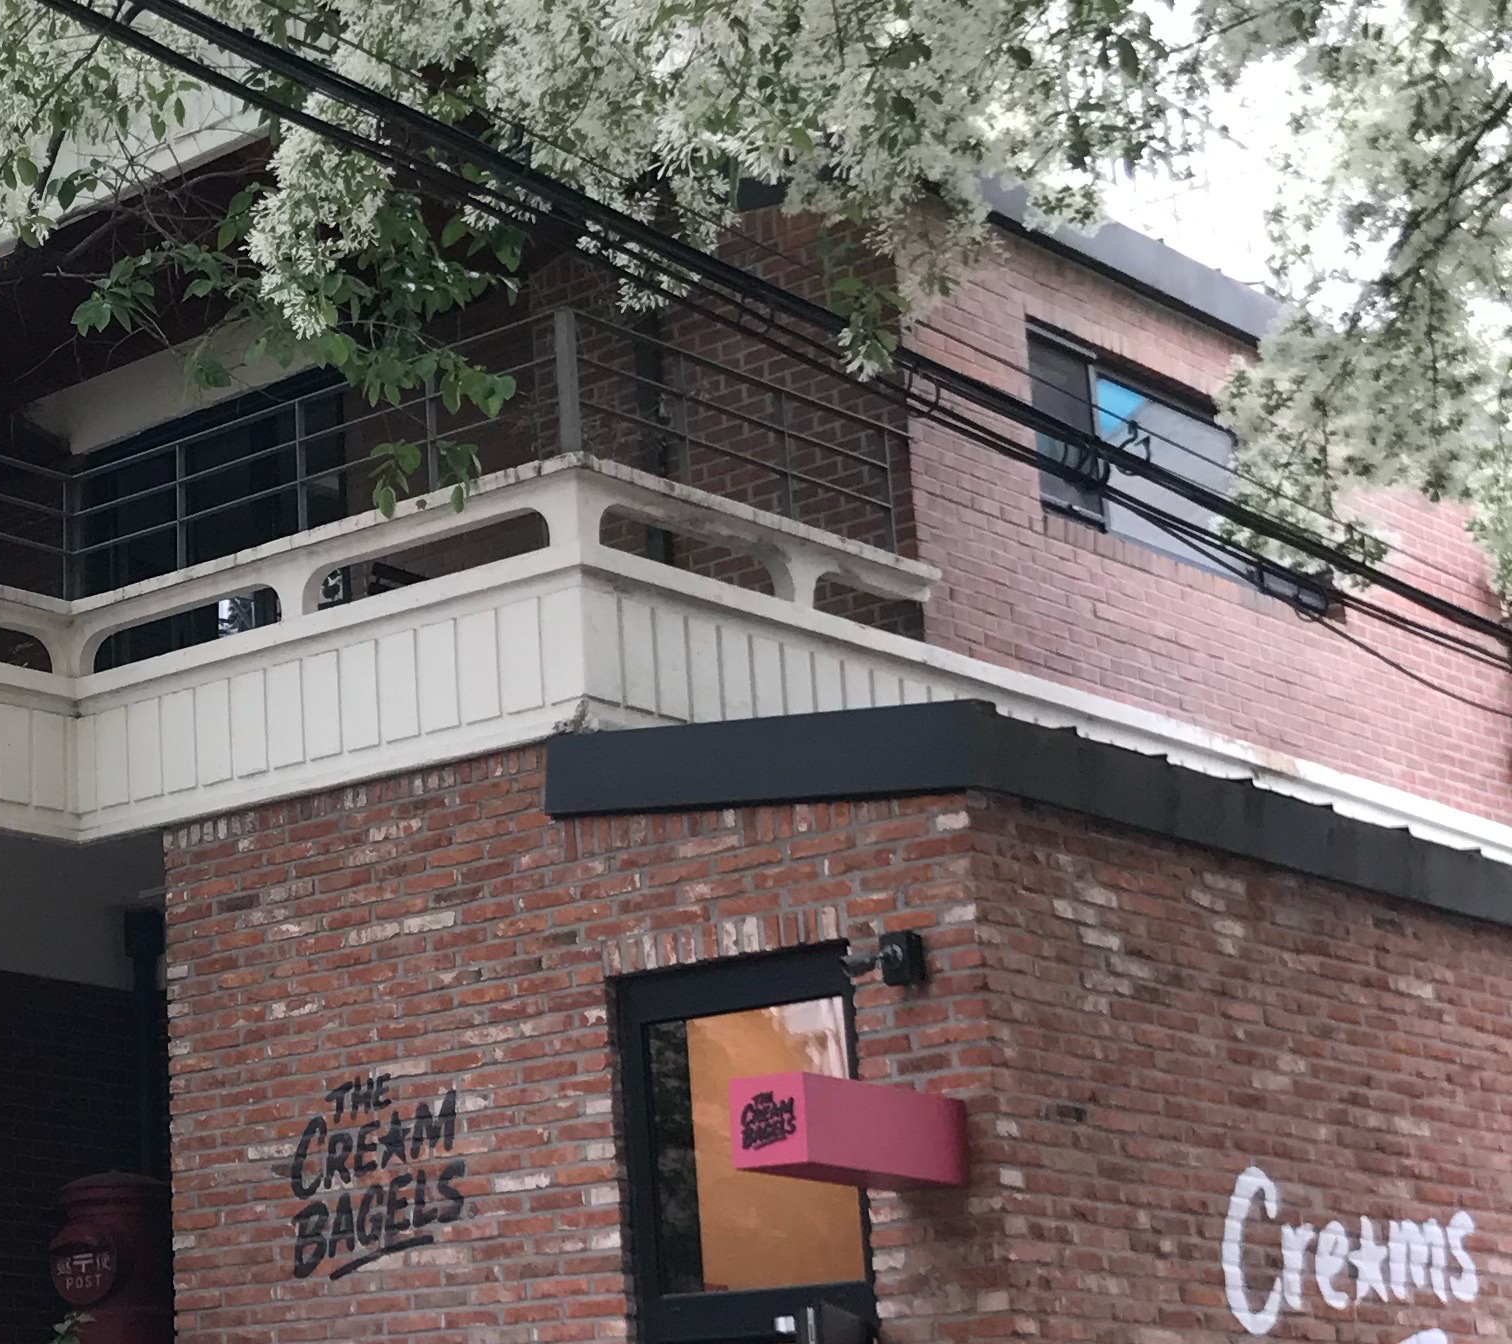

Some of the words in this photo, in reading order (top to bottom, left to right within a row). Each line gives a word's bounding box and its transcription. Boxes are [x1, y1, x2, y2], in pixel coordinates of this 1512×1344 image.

[326, 1074, 391, 1123] THE
[291, 1090, 457, 1199] CREAM
[291, 1160, 465, 1278] BAGELS
[66, 1273, 102, 1290] POST
